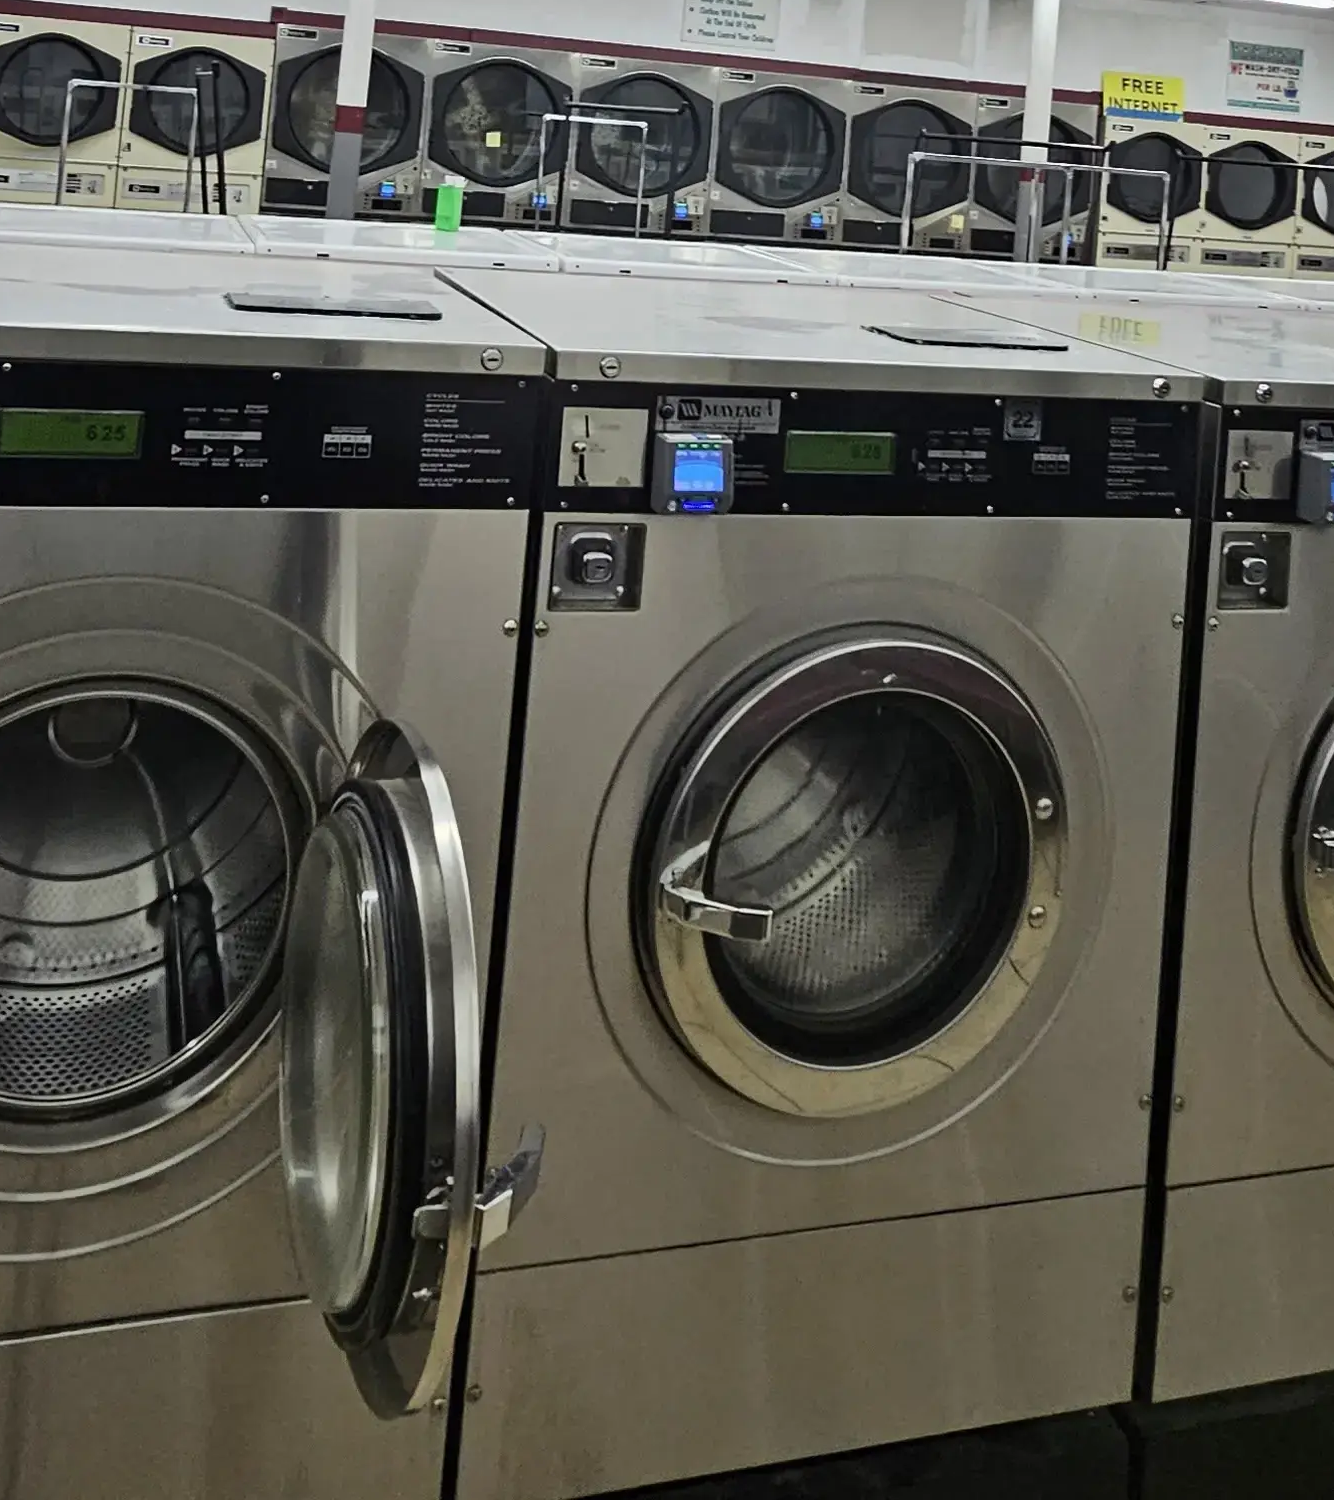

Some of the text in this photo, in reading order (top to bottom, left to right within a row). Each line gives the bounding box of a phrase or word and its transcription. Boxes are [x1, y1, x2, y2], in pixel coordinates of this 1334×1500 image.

[1122, 78, 1164, 95] FREE
[1108, 97, 1178, 114] INTERNET
[704, 404, 762, 418] MAYTAG
